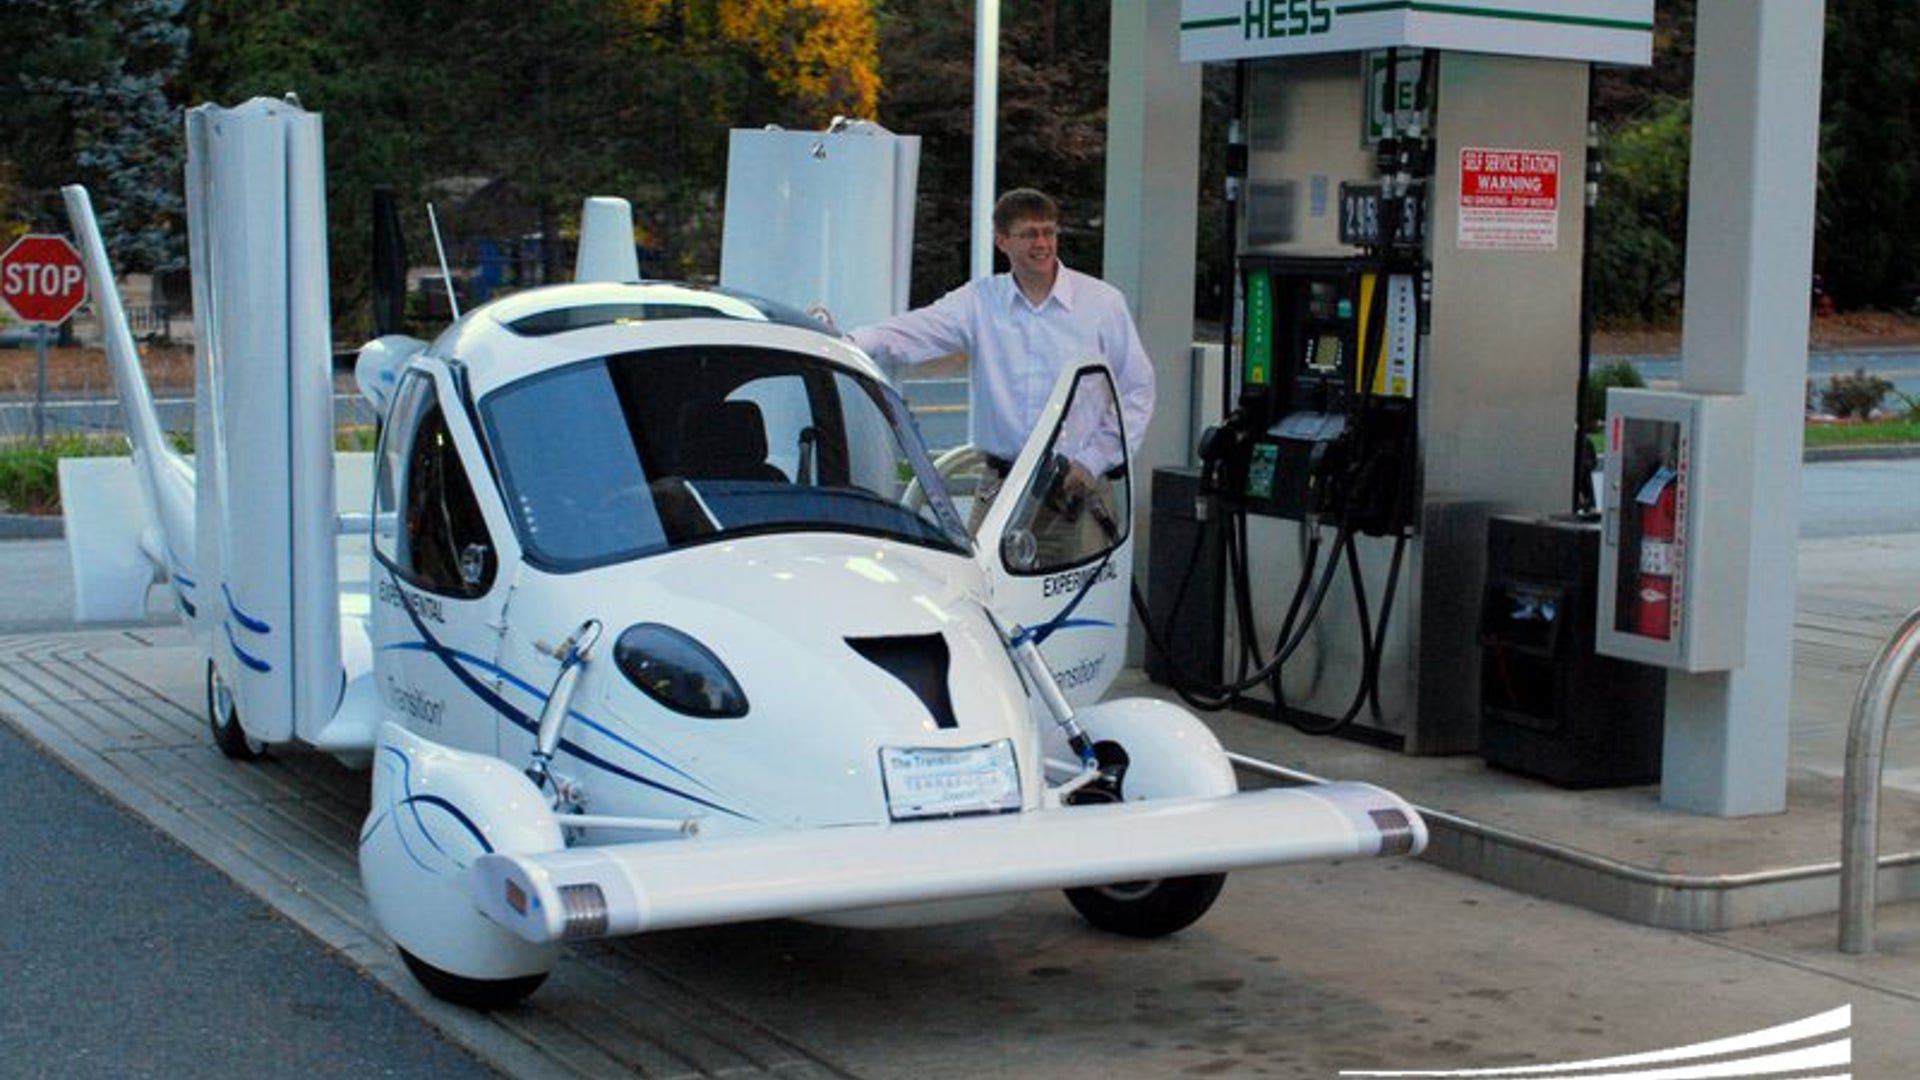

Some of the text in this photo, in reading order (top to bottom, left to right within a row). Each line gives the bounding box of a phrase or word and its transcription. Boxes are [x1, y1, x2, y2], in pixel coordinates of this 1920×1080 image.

[1245, 0, 1331, 39] HESS
[1463, 151, 1557, 174] SELF SERVICE STATION
[1478, 175, 1542, 192] WARNING
[4, 263, 81, 296] STOP
[1044, 562, 1117, 597] EXPERIMTAL
[379, 581, 445, 623] EXPEMENTAL
